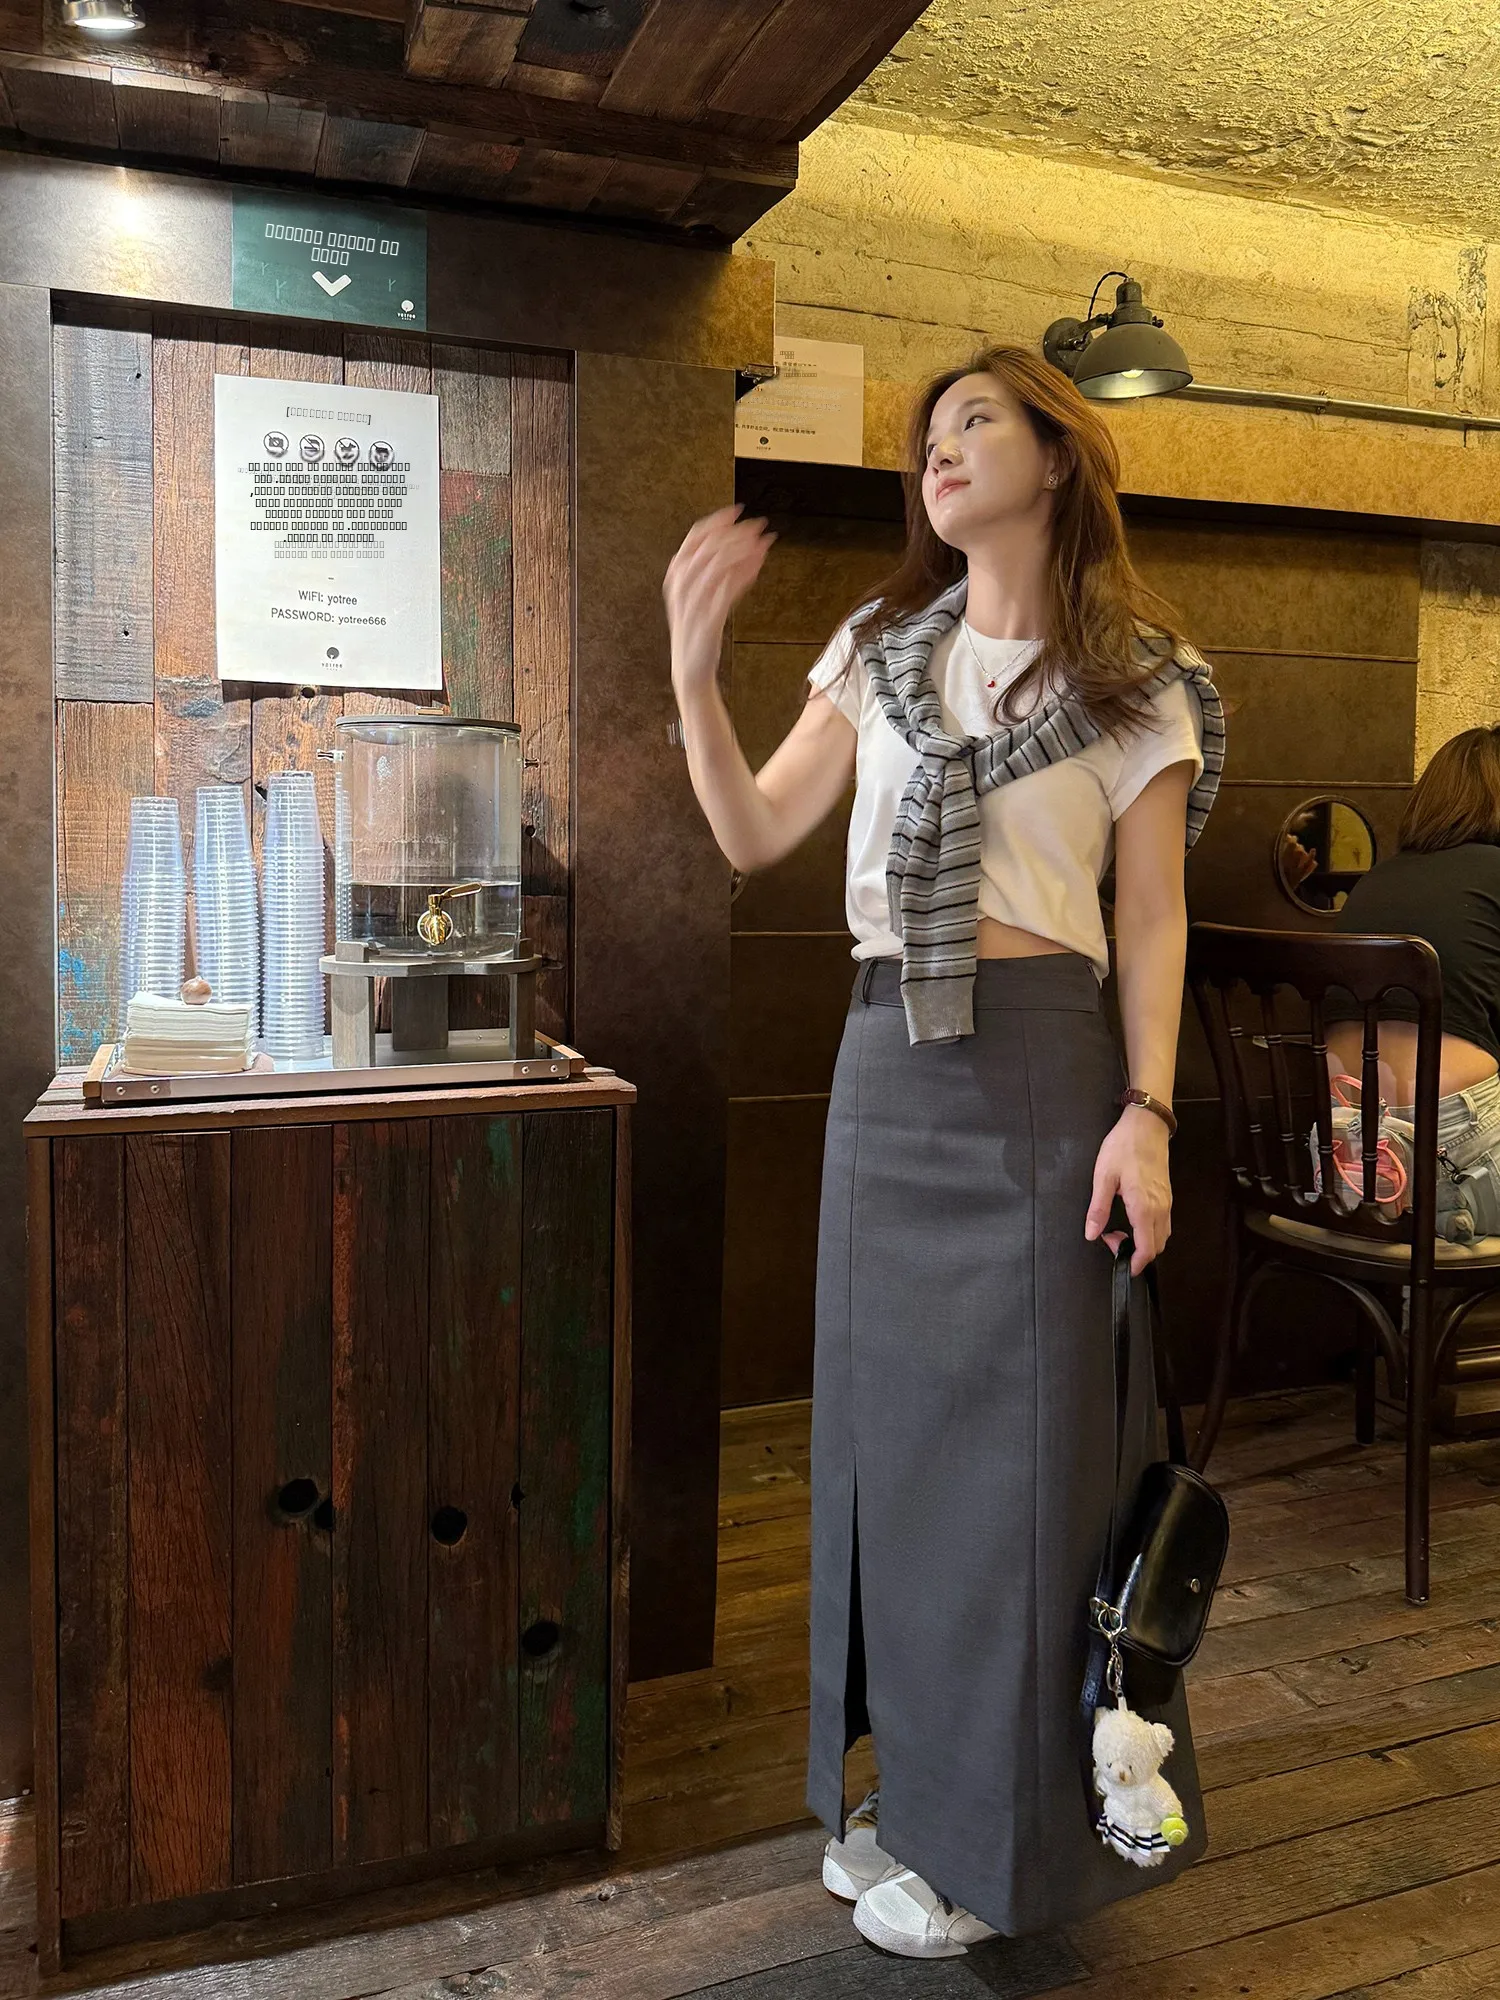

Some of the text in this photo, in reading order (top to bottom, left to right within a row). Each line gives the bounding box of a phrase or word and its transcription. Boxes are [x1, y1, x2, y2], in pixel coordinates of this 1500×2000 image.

[298, 590, 357, 606] WIFI: yotree
[271, 607, 387, 626] PASSWORD: yotree666
